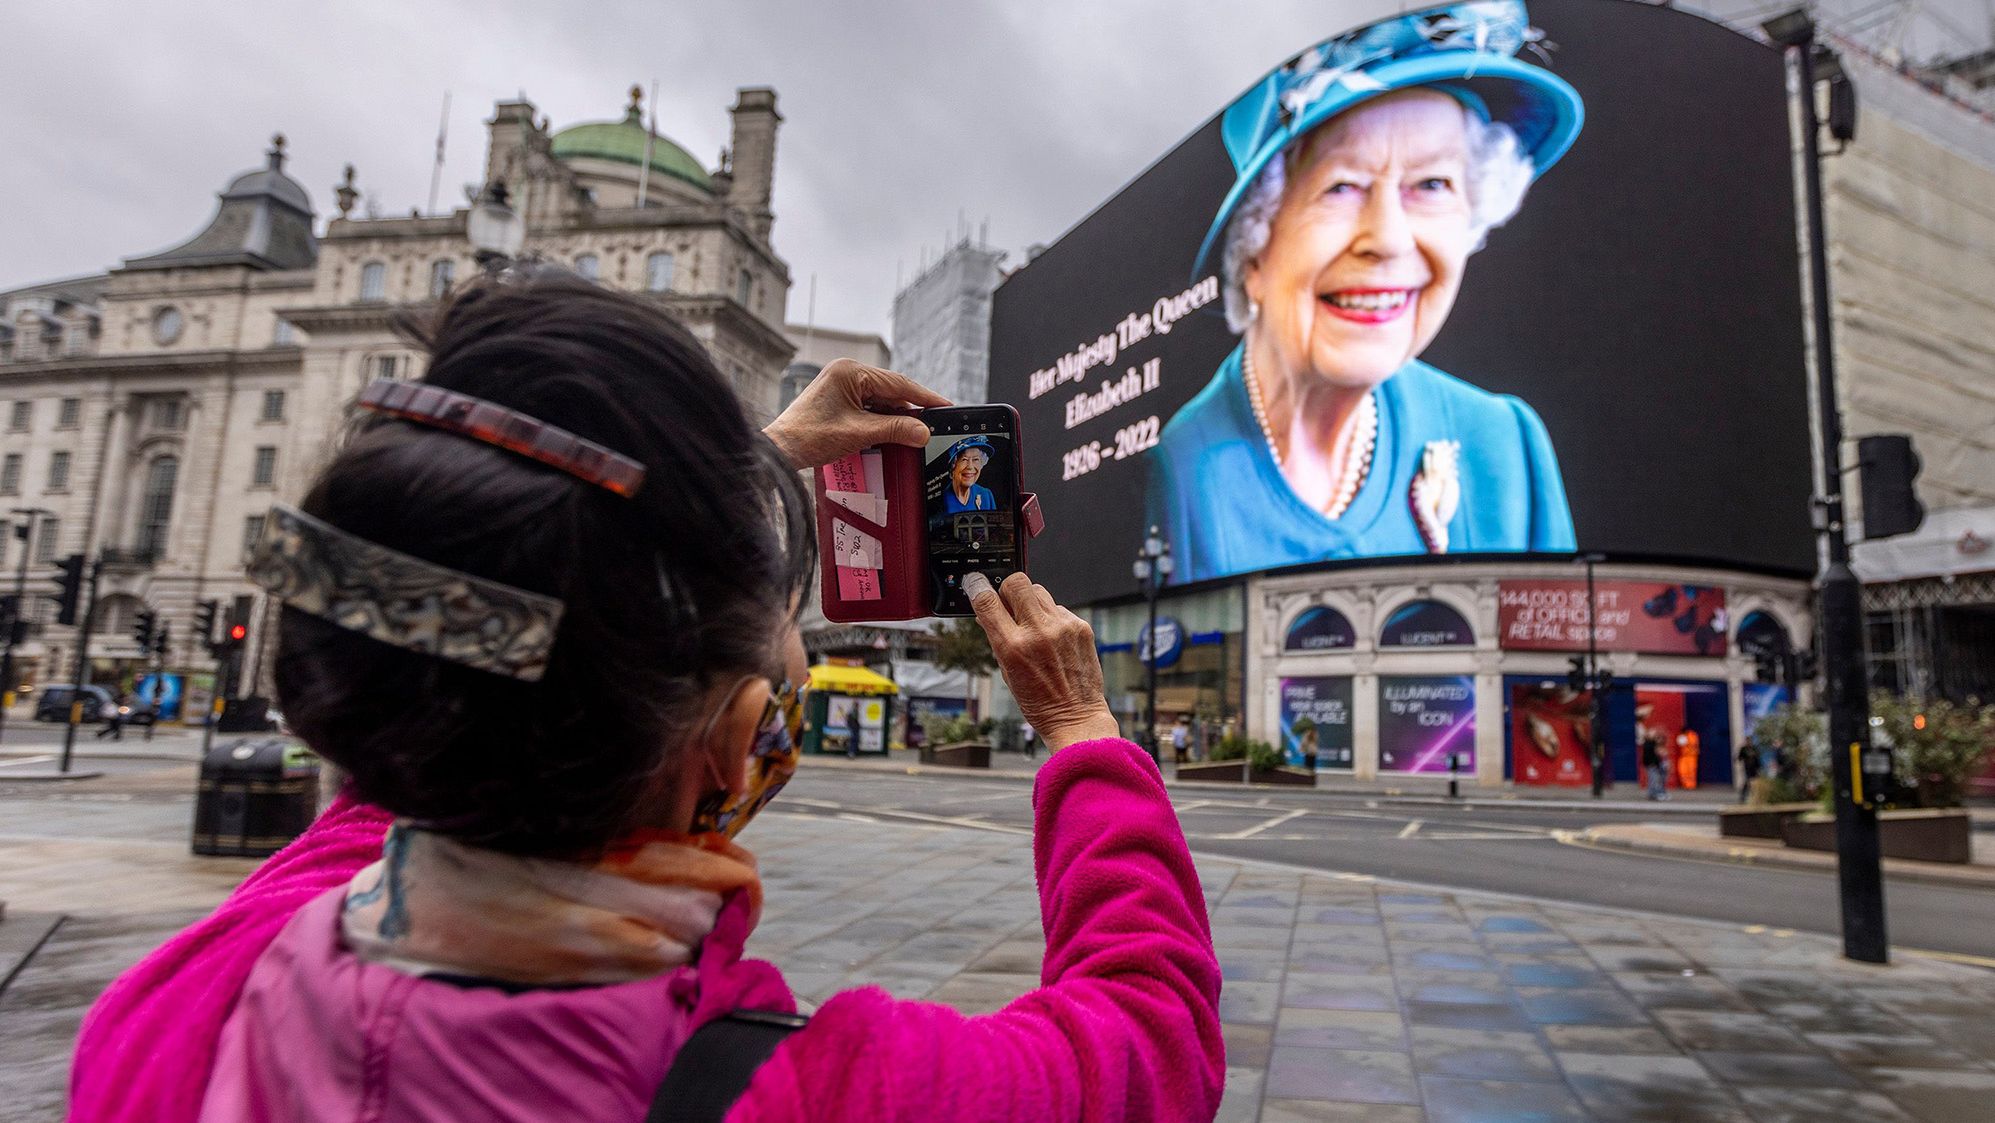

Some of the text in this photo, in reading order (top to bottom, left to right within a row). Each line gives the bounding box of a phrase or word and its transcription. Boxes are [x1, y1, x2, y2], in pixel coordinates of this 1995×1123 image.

[1029, 275, 1219, 400] Her Majesty The Queen
[1064, 357, 1161, 430] Elizabeth II
[1062, 440, 1101, 481] 1926
[1114, 415, 1160, 461] 2022
[1500, 589, 1568, 608] 144,000
[1598, 590, 1620, 608] FT
[1517, 608, 1535, 624] of
[1599, 609, 1631, 625] and
[1508, 623, 1564, 640] RETAIL
[1383, 687, 1467, 700] ILLUMINATED
[1295, 712, 1347, 724] AAILABLE
[1418, 712, 1454, 727] ICON
